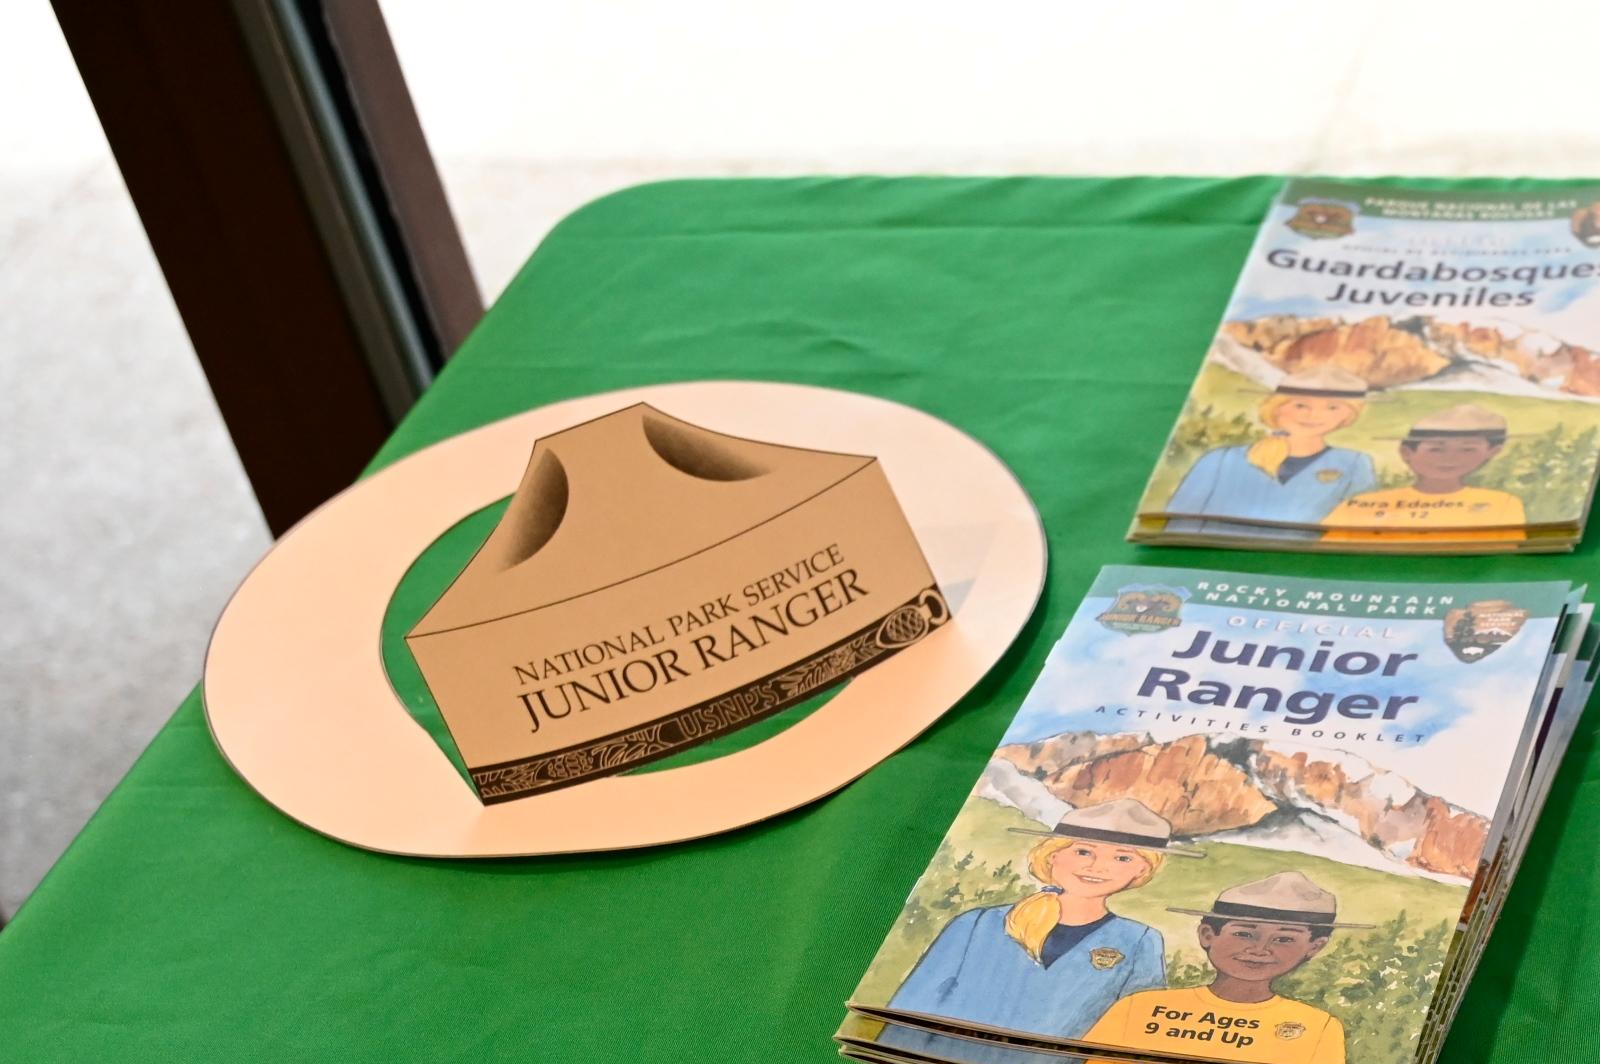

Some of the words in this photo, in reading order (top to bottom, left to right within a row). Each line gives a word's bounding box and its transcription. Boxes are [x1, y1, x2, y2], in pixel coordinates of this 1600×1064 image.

[1326, 281, 1536, 307] Juveniles
[1347, 500, 1389, 509] Para
[1395, 499, 1464, 509] Edades
[1197, 581, 1287, 597] ROCKY
[1305, 590, 1455, 606] MOUNTAIN
[1205, 592, 1347, 613] NATIONAL
[1366, 604, 1437, 615] PARK
[513, 624, 665, 686] NATIONAL
[666, 593, 741, 637] PARK
[742, 543, 845, 607] SERVICE
[1226, 614, 1402, 640] OFFICIAL
[517, 649, 692, 734] JUNIOR
[690, 568, 870, 671] RANGER
[1171, 629, 1419, 677] Junior
[1136, 666, 1419, 725] Ranger
[1095, 704, 1269, 734] ACTIVITIES
[1291, 727, 1425, 744] BOOKLET
[1151, 1004, 1193, 1022] For
[1197, 1011, 1261, 1030] Ages
[1144, 1021, 1160, 1035] 9
[1165, 1026, 1214, 1042] and
[1221, 1030, 1254, 1049] Up
